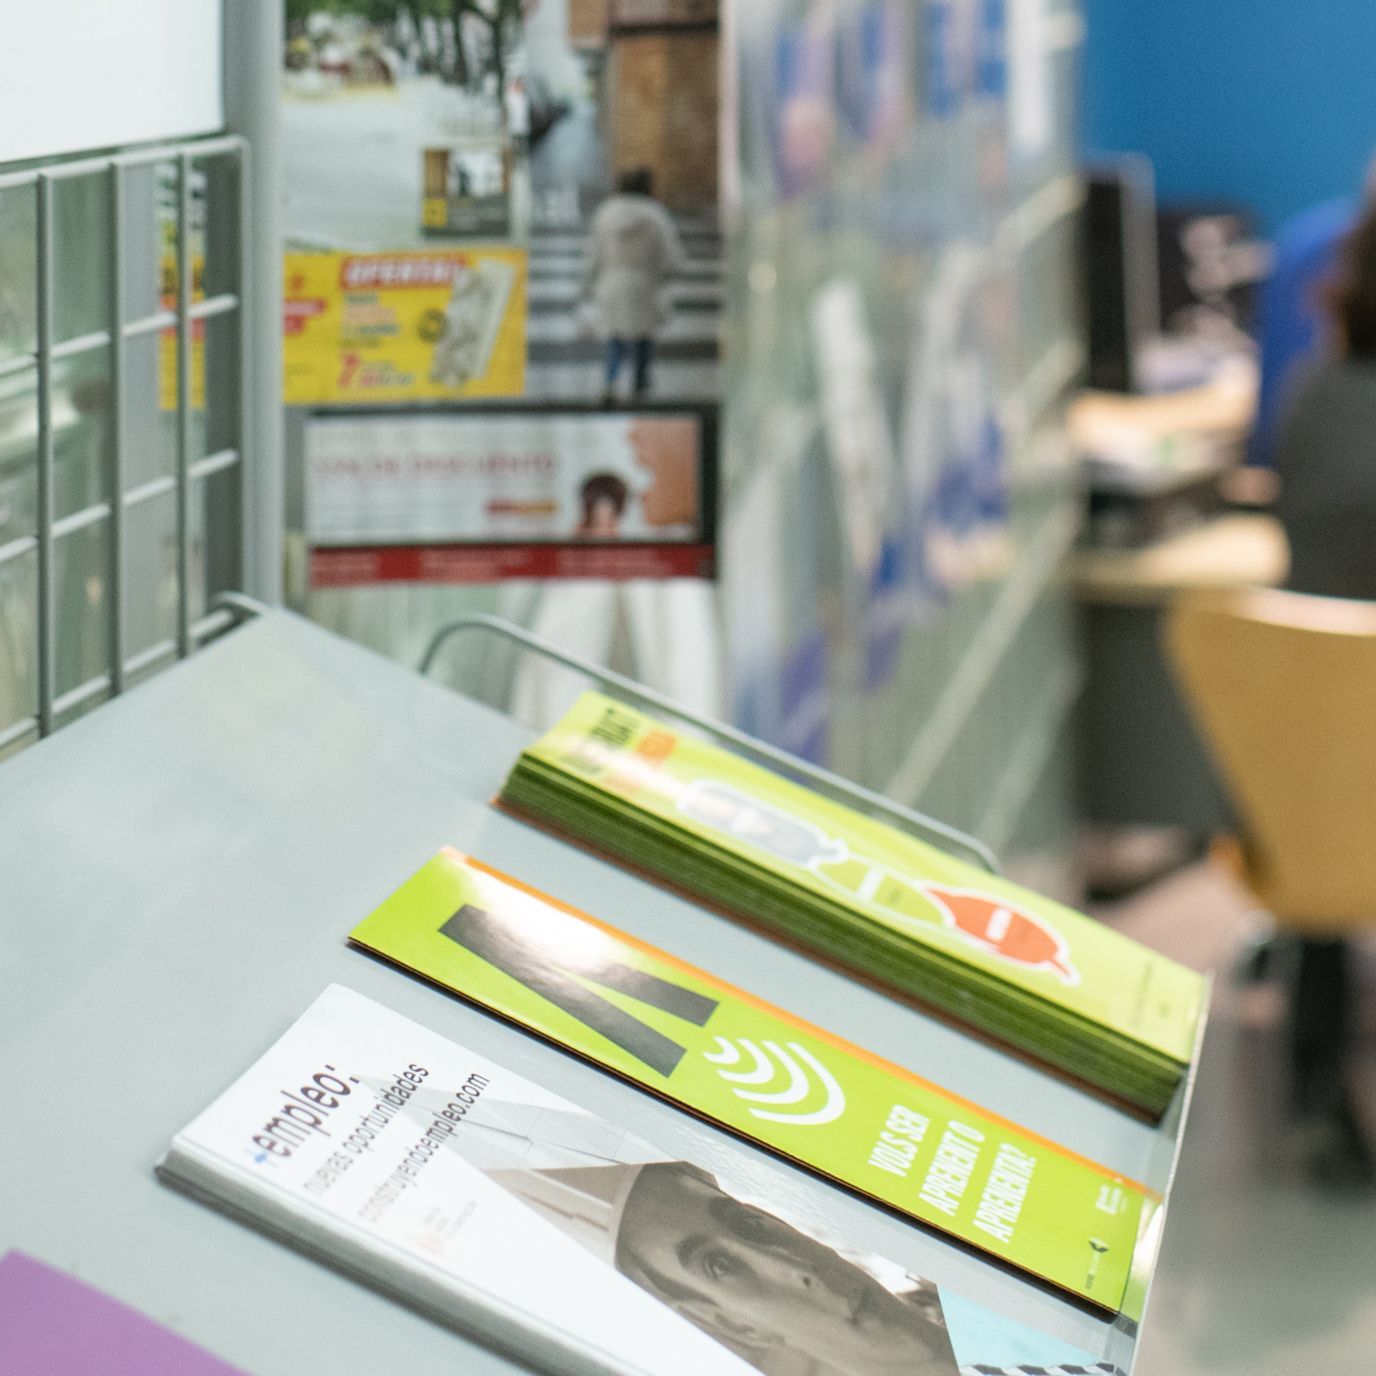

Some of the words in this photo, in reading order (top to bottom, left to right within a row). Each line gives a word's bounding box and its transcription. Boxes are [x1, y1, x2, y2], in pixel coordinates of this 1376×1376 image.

[302, 1150, 354, 1196] nuevas
[342, 1063, 431, 1154] oportunidades
[359, 1071, 492, 1222] construyendoempleo.com
[867, 1131, 919, 1178] VOLS
[885, 1104, 931, 1142] SER
[919, 1128, 982, 1217] APRENENT
[973, 1141, 1039, 1244] APRENENTA?
